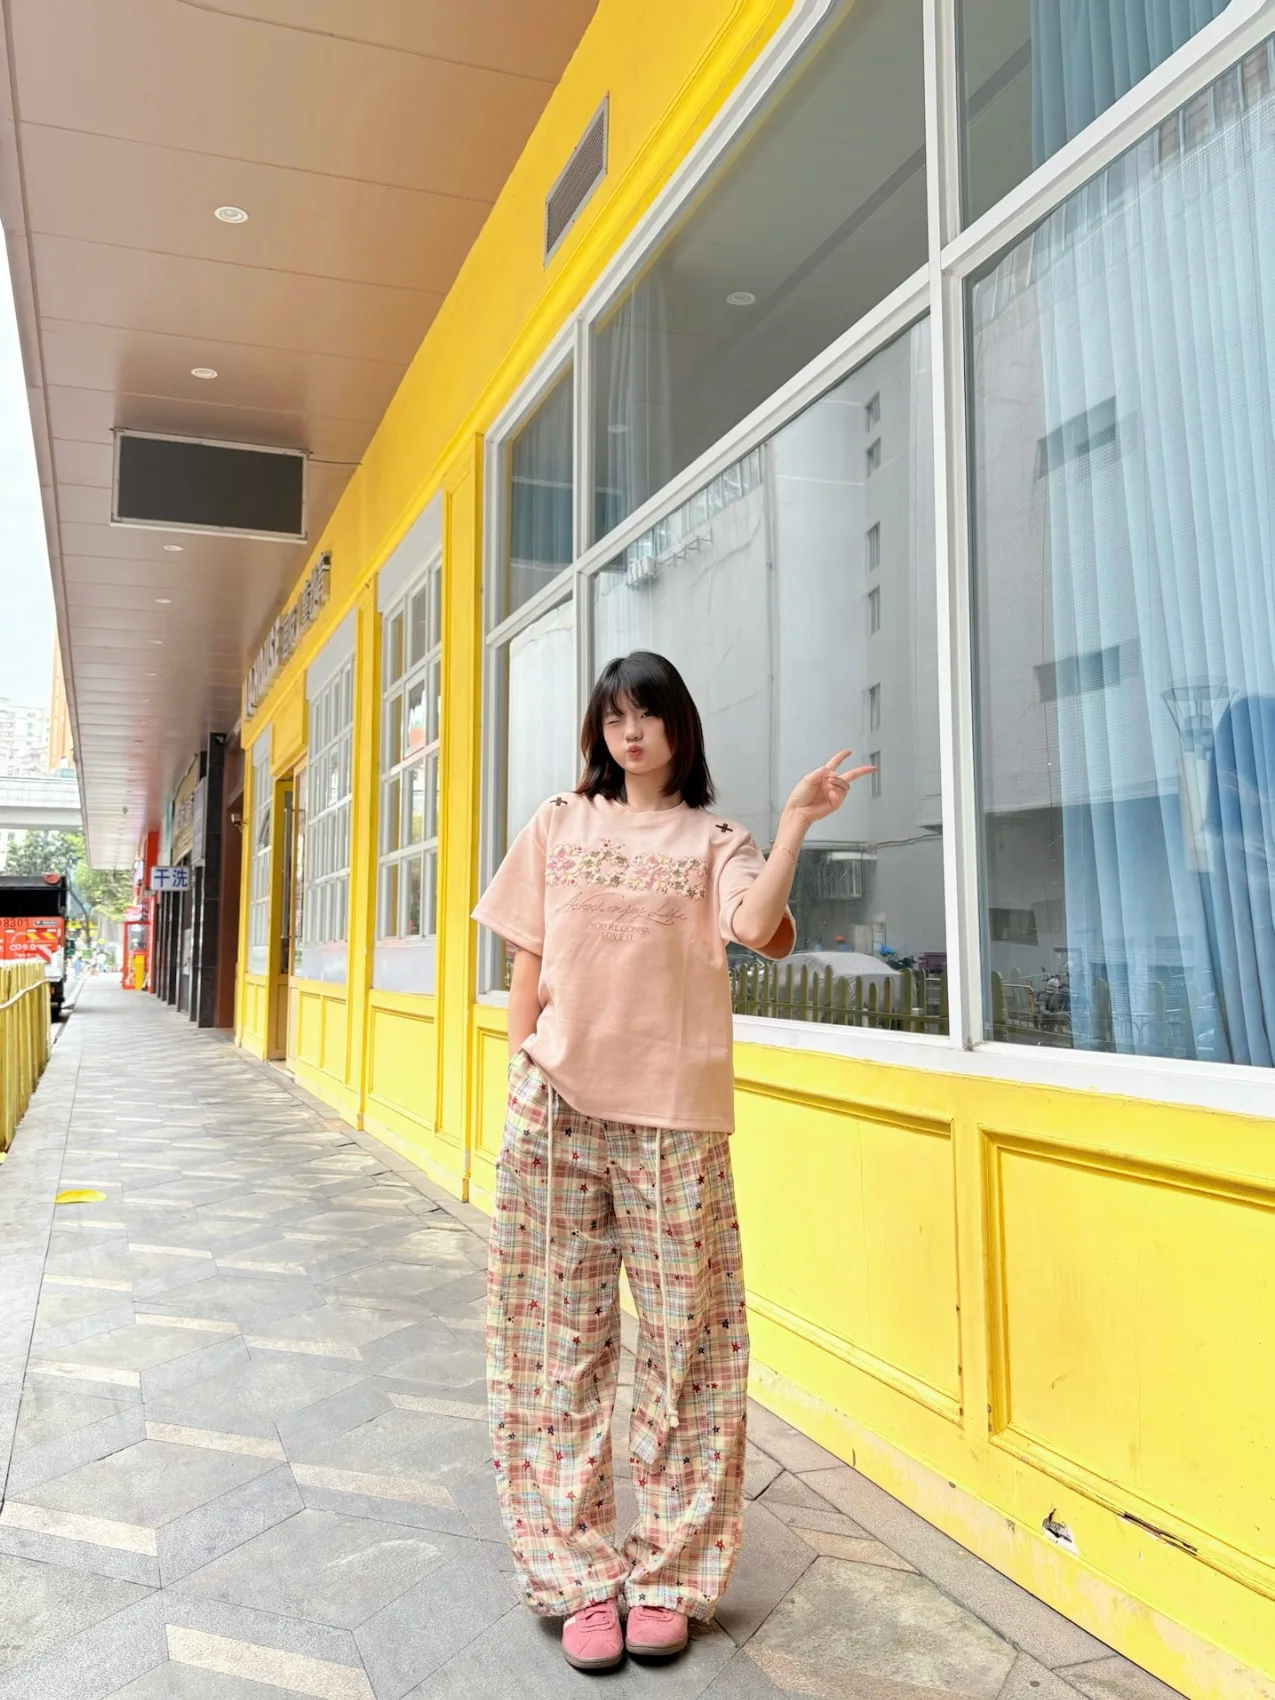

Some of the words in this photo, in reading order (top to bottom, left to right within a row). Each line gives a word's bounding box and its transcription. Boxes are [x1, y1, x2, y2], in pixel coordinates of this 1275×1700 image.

[154, 868, 188, 888] 干洗
[0, 918, 29, 928] 8301
[601, 931, 625, 940] LOVE
